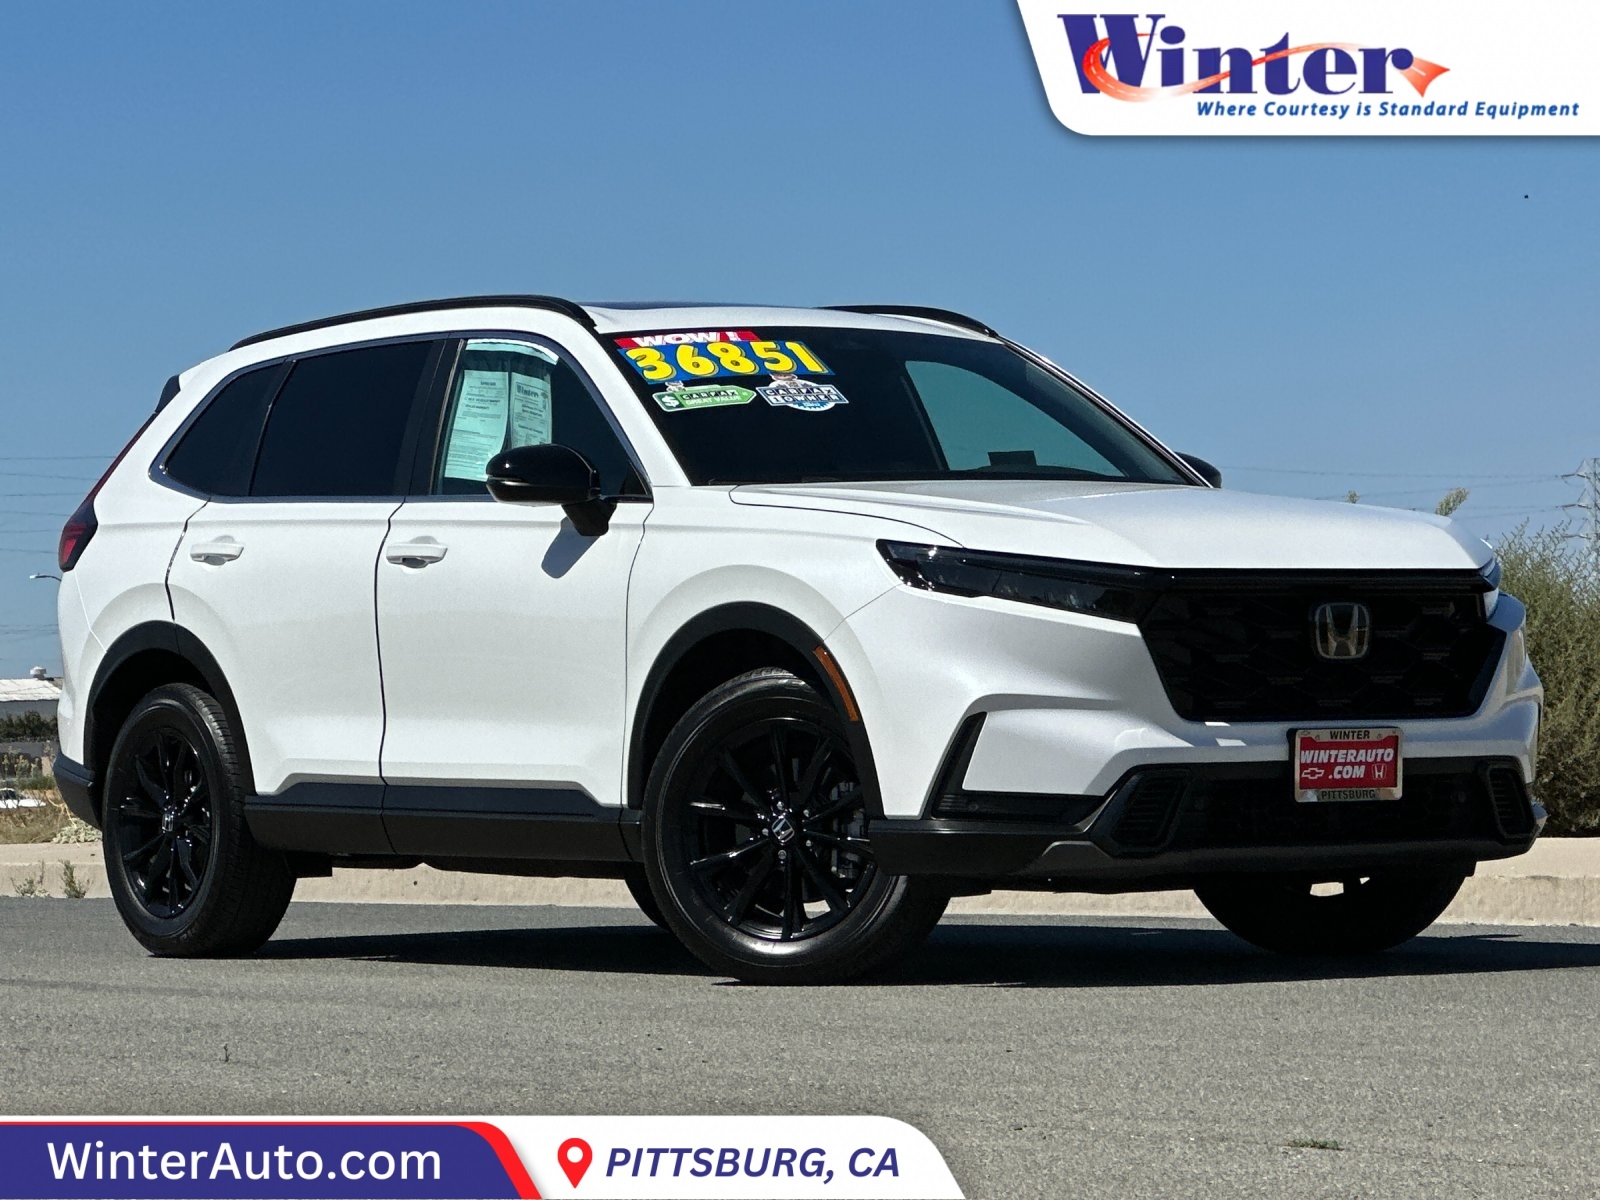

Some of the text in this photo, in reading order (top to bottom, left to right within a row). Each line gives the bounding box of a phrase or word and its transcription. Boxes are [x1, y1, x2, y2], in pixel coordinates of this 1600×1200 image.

[625, 341, 829, 381] 36851
[680, 389, 738, 401] CARFAX
[764, 387, 837, 396] CARFAX
[783, 394, 840, 403] OWNER
[1329, 730, 1371, 740] WINTER
[1300, 748, 1395, 764] WINTERAUTO
[1327, 765, 1366, 780] .COM
[1321, 789, 1376, 801] PITTSBURG
